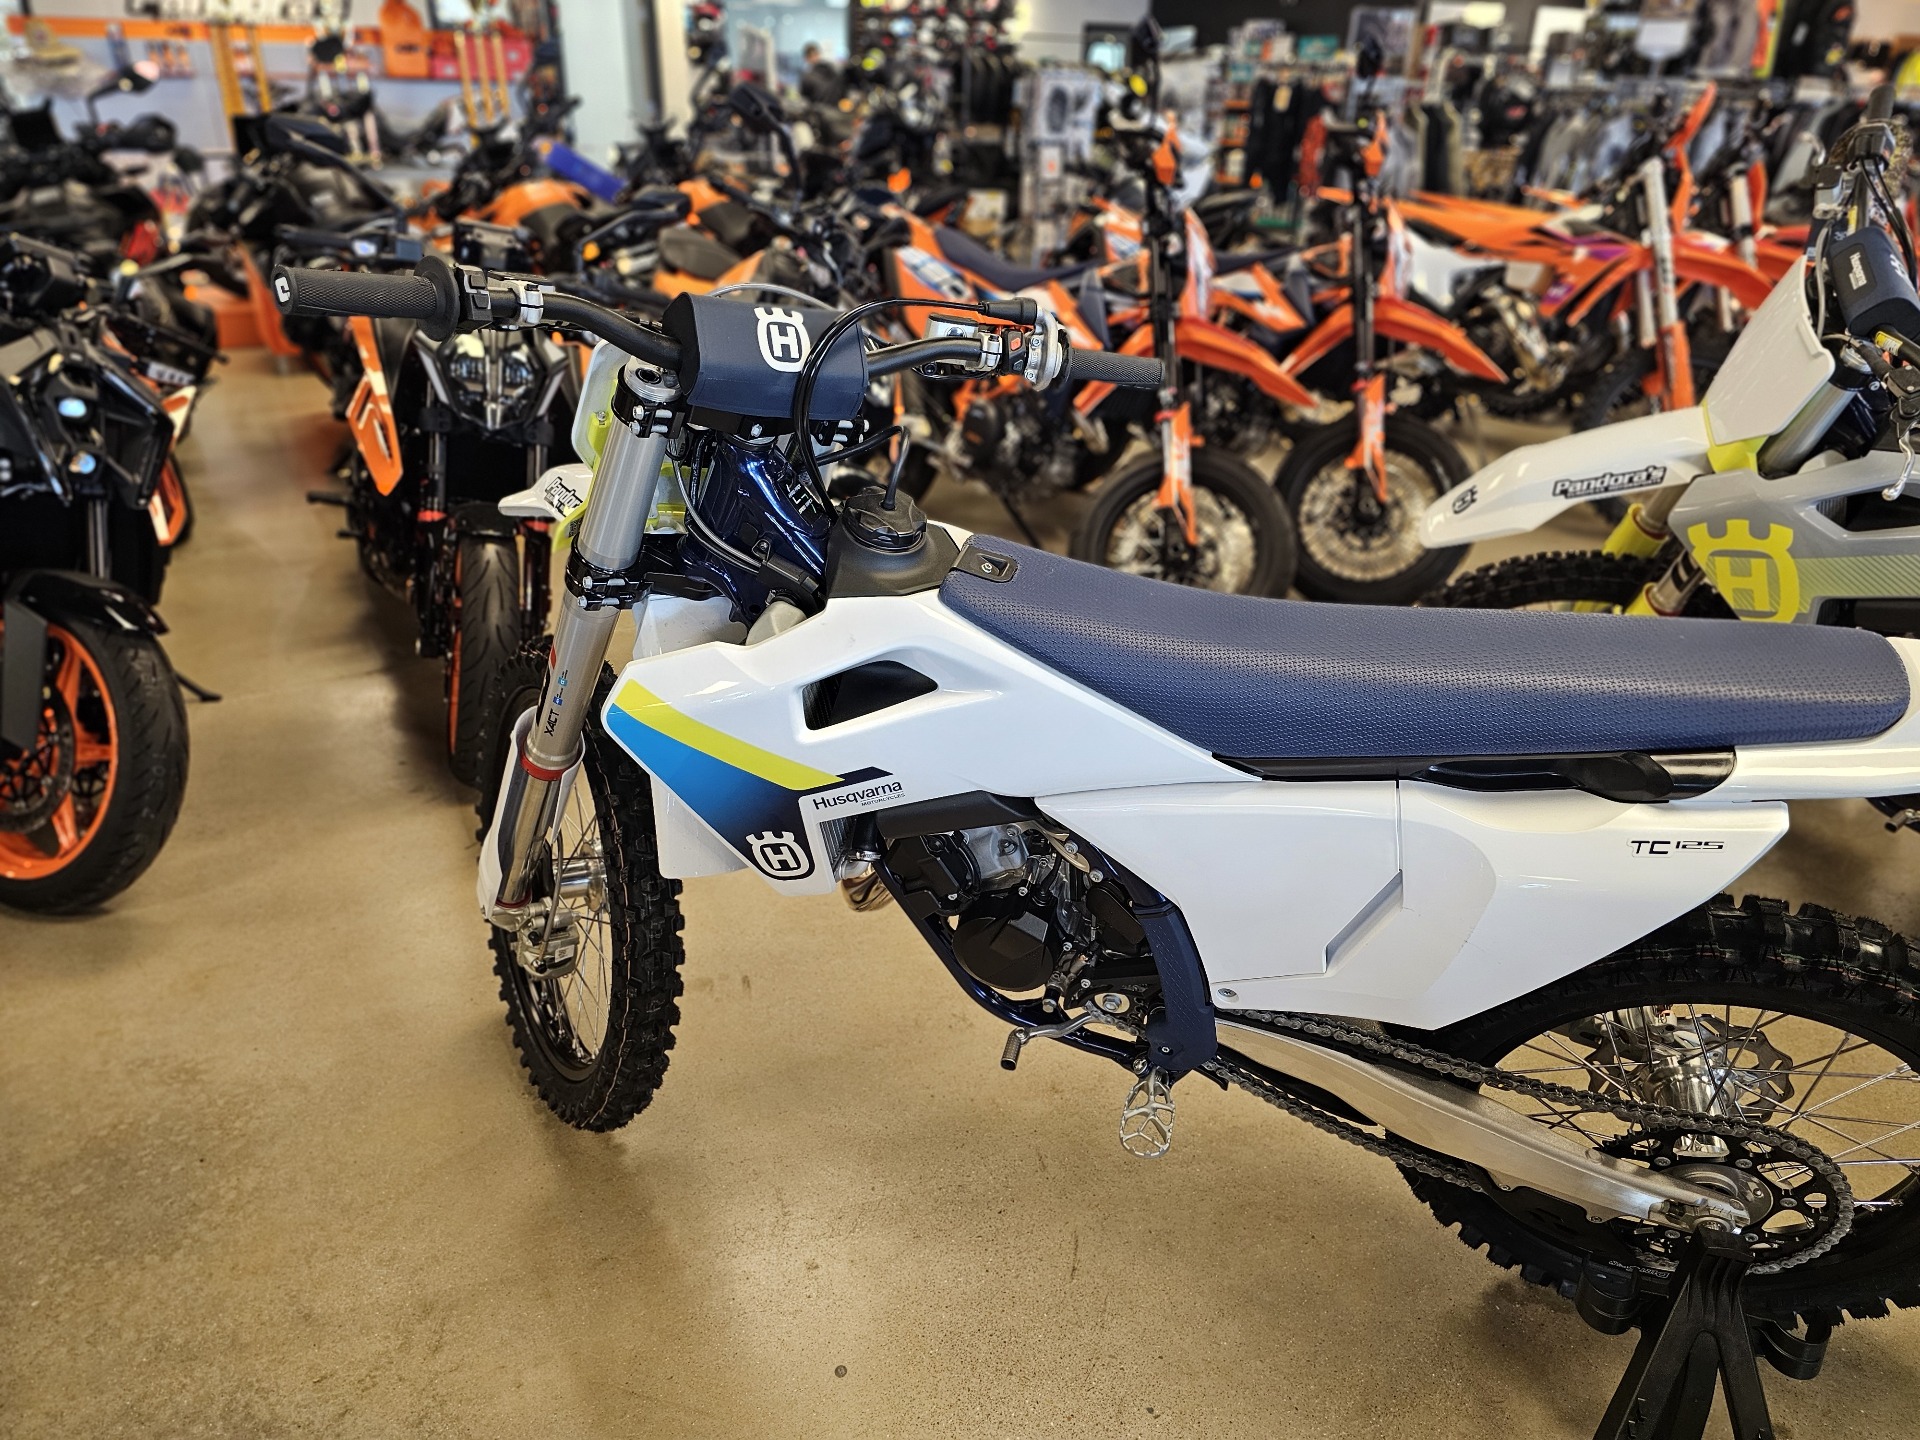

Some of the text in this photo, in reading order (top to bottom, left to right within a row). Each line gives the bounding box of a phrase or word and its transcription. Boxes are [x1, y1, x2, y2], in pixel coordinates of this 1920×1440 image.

[546, 477, 582, 509] Pandor
[544, 708, 560, 737] XACT
[813, 781, 903, 810] Husqvarna
[1630, 840, 1725, 855] TC 125
